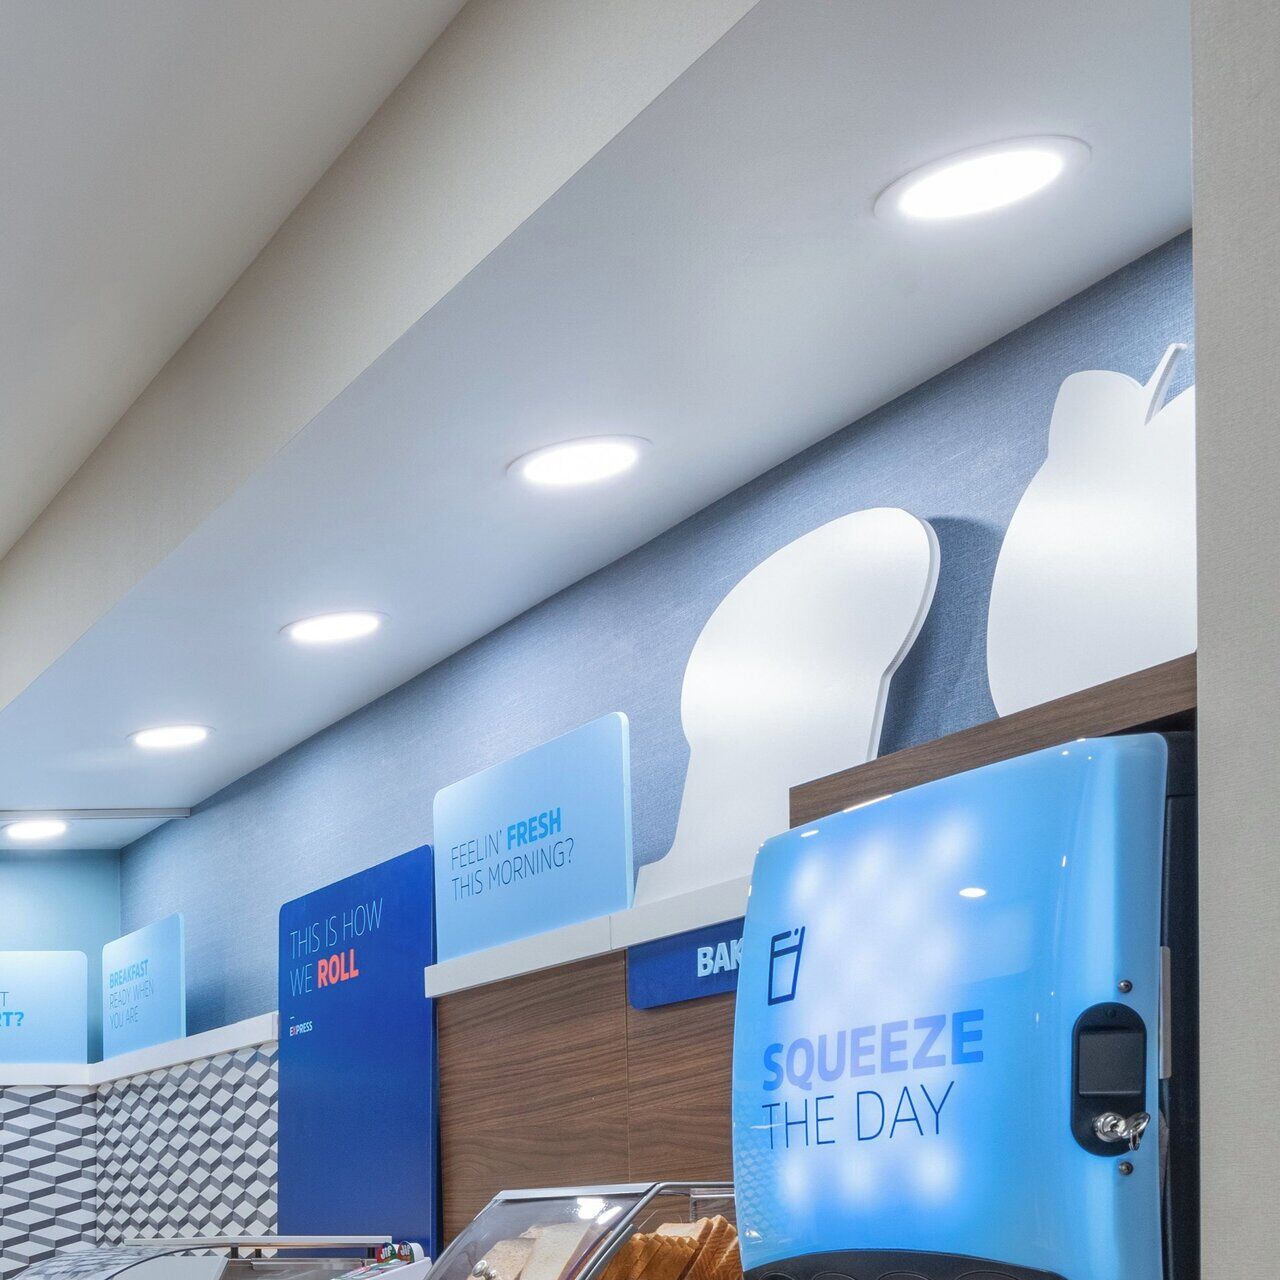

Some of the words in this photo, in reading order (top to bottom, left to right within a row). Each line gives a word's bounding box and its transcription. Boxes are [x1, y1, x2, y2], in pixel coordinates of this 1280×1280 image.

[506, 807, 561, 850] FRESH
[451, 869, 483, 901] THIS
[488, 837, 574, 890] MORNING?
[289, 922, 320, 960] THIS
[325, 915, 338, 947] IS
[343, 897, 383, 941] HOW
[109, 959, 149, 989] BREAKFAST
[110, 985, 131, 1009] READY
[132, 979, 154, 1001] WHEN
[289, 963, 313, 997] WE
[317, 948, 360, 989] ROLL
[109, 1010, 124, 1030] YOU
[126, 1005, 139, 1024] ARE
[289, 1020, 313, 1037] EXPRESS
[762, 1008, 984, 1091] SQUEEZE
[761, 1095, 835, 1150] THE
[856, 1081, 955, 1142] DAY
